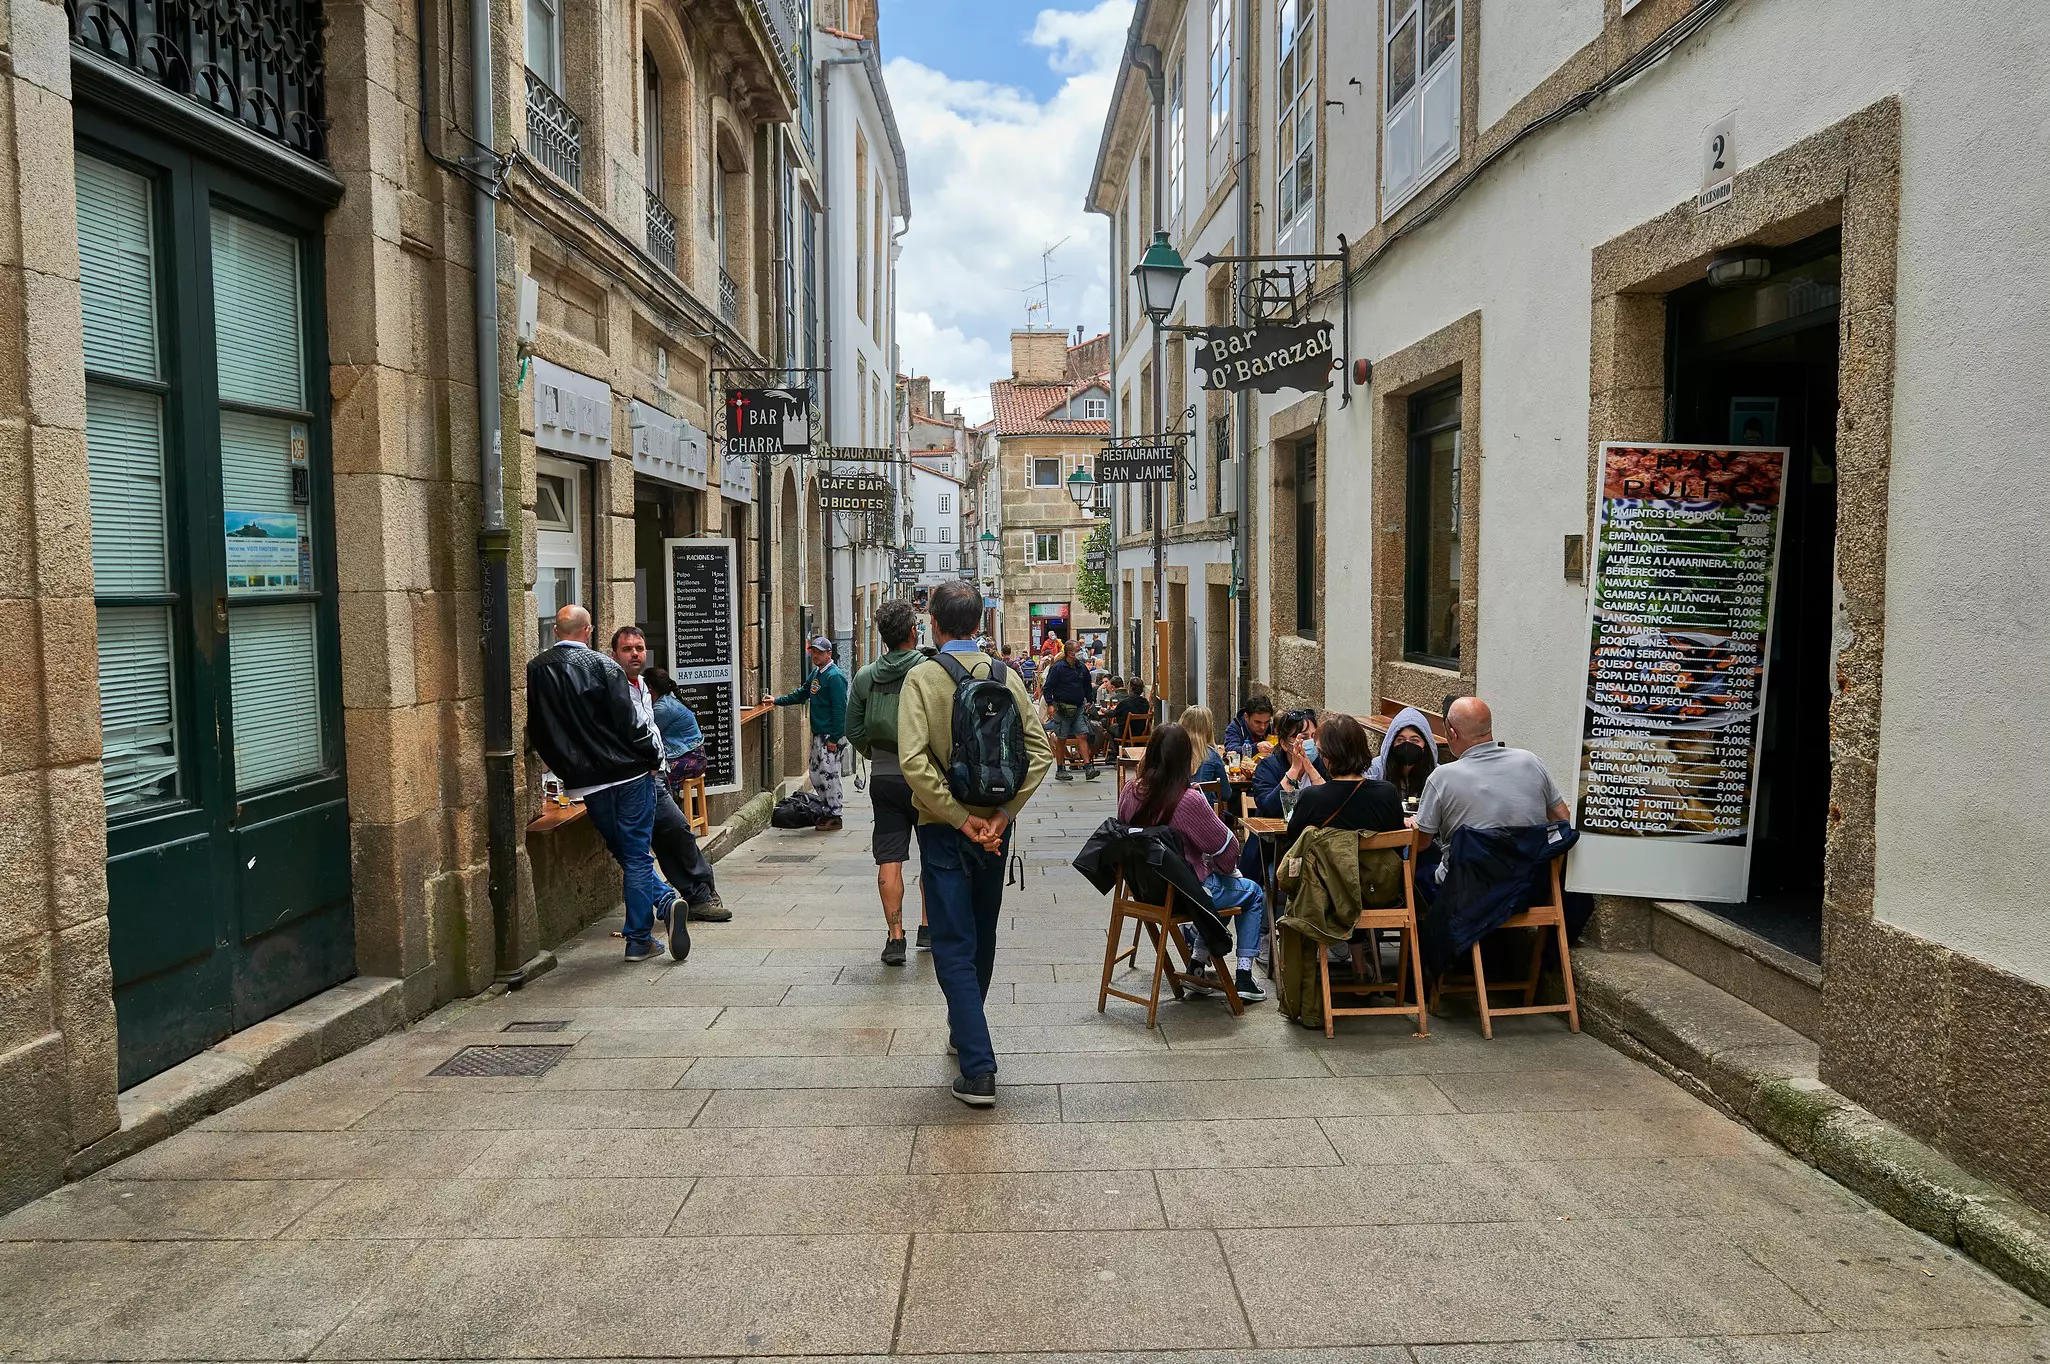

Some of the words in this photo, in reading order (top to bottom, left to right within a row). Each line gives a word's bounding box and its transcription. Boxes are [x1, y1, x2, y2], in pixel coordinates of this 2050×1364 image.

[1712, 134, 1725, 171] 2
[1210, 329, 1257, 362] Bar
[749, 409, 777, 425] BAR
[729, 437, 783, 453] CHARRA
[818, 446, 893, 460] RESTAURANTE
[1102, 447, 1173, 461] RESTAURANTE
[1656, 453, 1738, 471] HAY
[1103, 467, 1129, 480] SAN
[1136, 465, 1173, 480] JAIME
[821, 478, 855, 490] CAFE
[858, 479, 883, 491] BAR
[820, 497, 829, 508] O
[831, 497, 884, 509] BIGOTES
[1610, 508, 1664, 518] PIMIENTOS
[1666, 510, 1681, 519] DE
[1682, 509, 1725, 520] PADRÓN
[1743, 513, 1771, 522] 5,00€
[1609, 519, 1643, 529] PULPO
[1608, 531, 1665, 541] EMPANADA
[1741, 538, 1770, 546] 4,50€
[1608, 543, 1667, 554] MEJILLONES
[1738, 549, 1767, 558] 6,00€
[1606, 555, 1651, 565] ALMEJAS
[1653, 557, 1661, 565] A
[1733, 561, 1766, 570] 10,00€
[1606, 566, 1676, 577] BERBERECHOS
[1737, 573, 1765, 582] 6,00€
[1605, 578, 1649, 588] NAVAJAS
[1736, 585, 1765, 594] 9,00€
[1604, 590, 1646, 600] GAMBAS
[1648, 592, 1656, 600] A
[1658, 592, 1671, 600] LA
[1673, 593, 1721, 603] PLANCHA
[1735, 596, 1763, 605] 9,00€
[1603, 602, 1646, 612] GAMBAS
[1647, 604, 1660, 612] AL
[1662, 604, 1695, 614] AJILLO
[1729, 608, 1762, 617] 10,00€
[1602, 613, 1673, 624] LANGOSTINOS
[1727, 620, 1760, 629] 12,00€
[1600, 625, 1661, 635] CALAMARES
[1731, 631, 1759, 640] 8,00€
[1600, 636, 1668, 647] BOQUERONES
[1730, 644, 1757, 652] 5,00€
[1598, 647, 1635, 657] JAMÓN
[1636, 649, 1683, 660] SERRANO
[1730, 655, 1758, 664] 7,00€
[678, 671, 693, 680] HAY
[1598, 659, 1632, 669] QUESO
[1634, 661, 1681, 672] GALLEGO
[1728, 667, 1755, 676] 5,00€
[1597, 670, 1622, 680] SOPA
[1624, 672, 1638, 680] DE
[1640, 673, 1686, 684] MARISCO
[1727, 678, 1755, 687] 5,00€
[1596, 682, 1648, 693] ENSALADA
[1650, 685, 1680, 695] MIXTA
[1726, 690, 1754, 699] 5,50€
[1593, 705, 1622, 714] RAXO
[1595, 693, 1647, 704] ENSALADA
[1650, 696, 1692, 707] ESPECIAL
[1725, 701, 1752, 710] 9,00€
[1592, 716, 1632, 727] PATATAS
[1634, 719, 1672, 728] BRAVAS
[1723, 725, 1751, 734] 4,00€
[1592, 728, 1651, 738] CHIPIRONES
[1723, 736, 1750, 745] 8,00€
[1590, 740, 1656, 751] ZAMBURIÑAS
[1715, 747, 1748, 757] 11,00€
[1589, 751, 1635, 761] CHORIZO
[1637, 754, 1649, 762] AL
[1651, 755, 1676, 764] VINO
[1589, 762, 1619, 772] VIEIRA
[1622, 763, 1668, 775] (UNIDAD)
[1719, 771, 1747, 780] 5,00€
[1588, 773, 1650, 785] ENTREMESES
[1652, 778, 1690, 788] MIXTOS
[1717, 782, 1745, 791] 8,00€
[1587, 785, 1646, 796] CROQUETAS
[1717, 793, 1743, 803] 5,00€
[1586, 796, 1624, 806] RACION
[1626, 798, 1640, 807] DE
[1643, 799, 1688, 811] TORTILLA
[1714, 805, 1742, 814] 4,00€
[1585, 807, 1623, 817] RACION
[1624, 810, 1638, 818] DE
[1640, 811, 1674, 821] LACON
[1714, 816, 1741, 826] 6,00€
[1584, 818, 1619, 828] CALDO
[1620, 821, 1667, 832] GALLEGO
